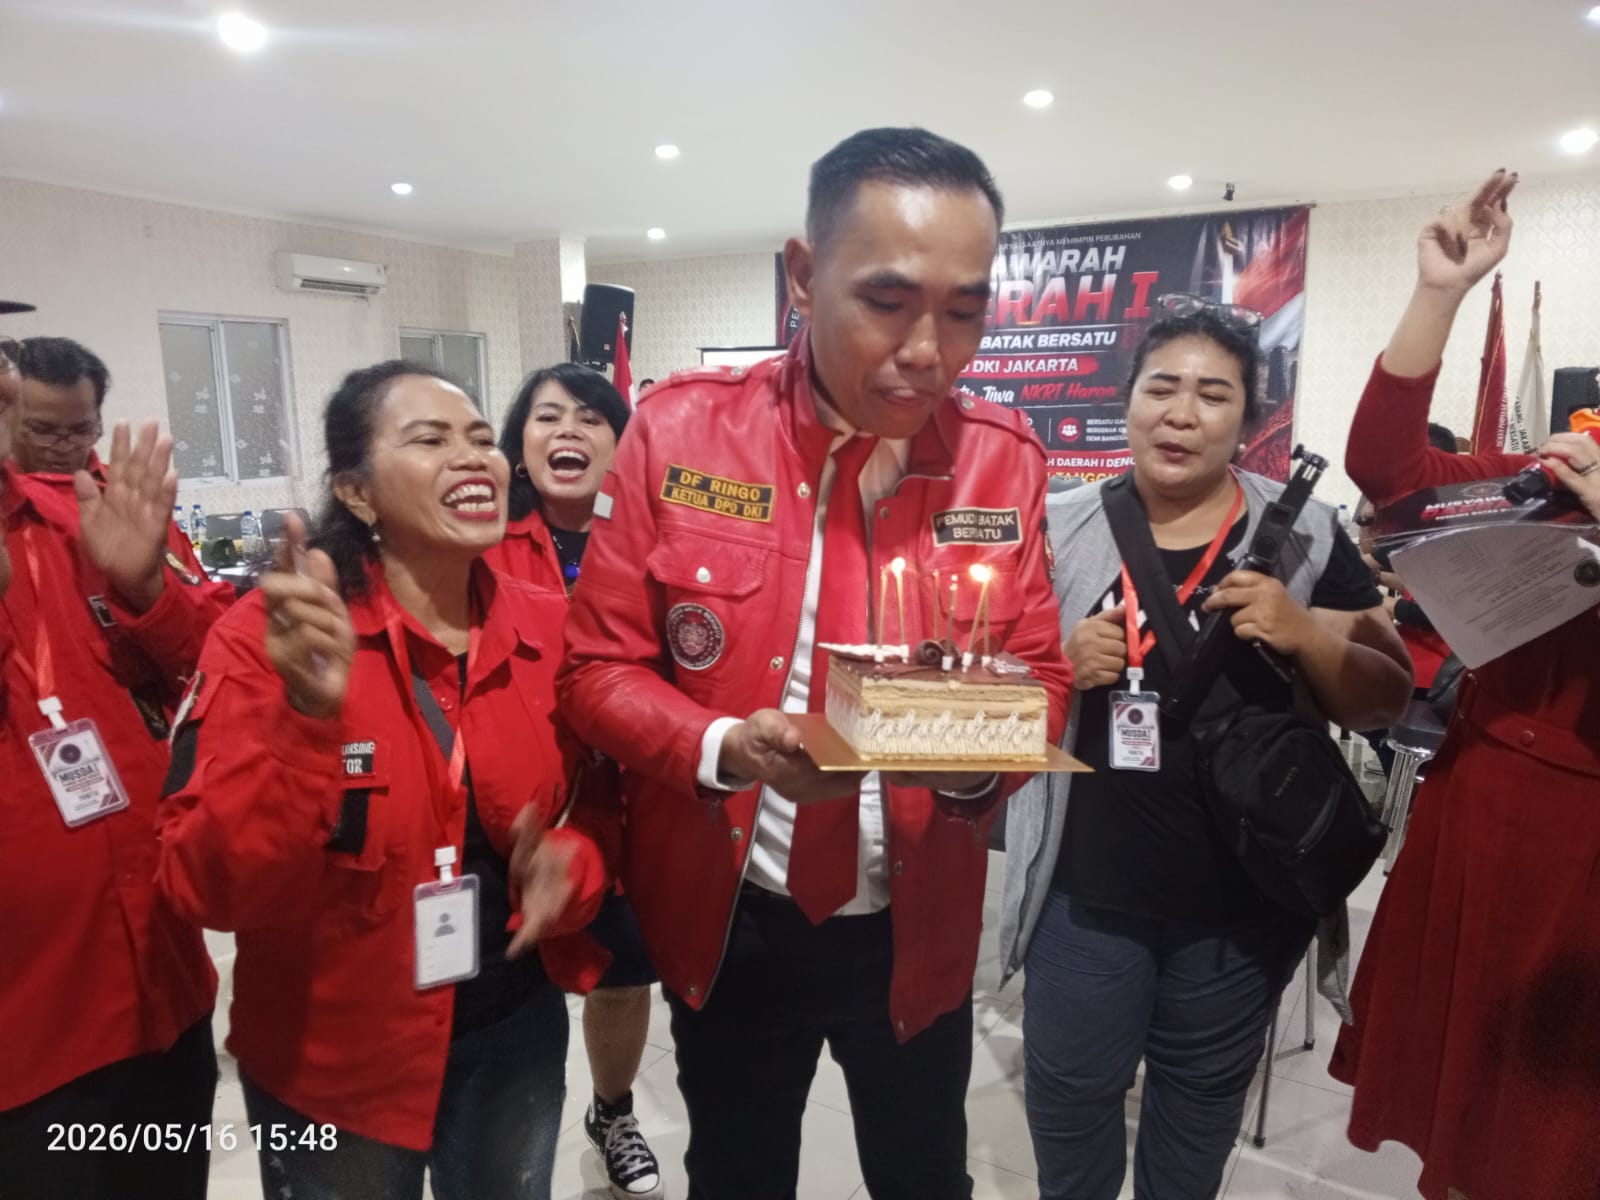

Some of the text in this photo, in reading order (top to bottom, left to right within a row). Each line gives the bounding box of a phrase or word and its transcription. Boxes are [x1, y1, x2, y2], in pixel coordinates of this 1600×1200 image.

[1096, 231, 1142, 242] PERUBAHAN
[1123, 271, 1159, 319] I
[980, 331, 1117, 349] BATAK BERSATU
[973, 360, 1000, 373] DKI
[1003, 358, 1079, 373] JAKARTA
[1020, 383, 1064, 402] NKRI
[1057, 458, 1099, 468] DAERAH
[680, 471, 761, 501] DF RINGO
[671, 487, 709, 507] KETUA
[743, 505, 763, 518] DKI
[59, 765, 94, 783] MUSDA
